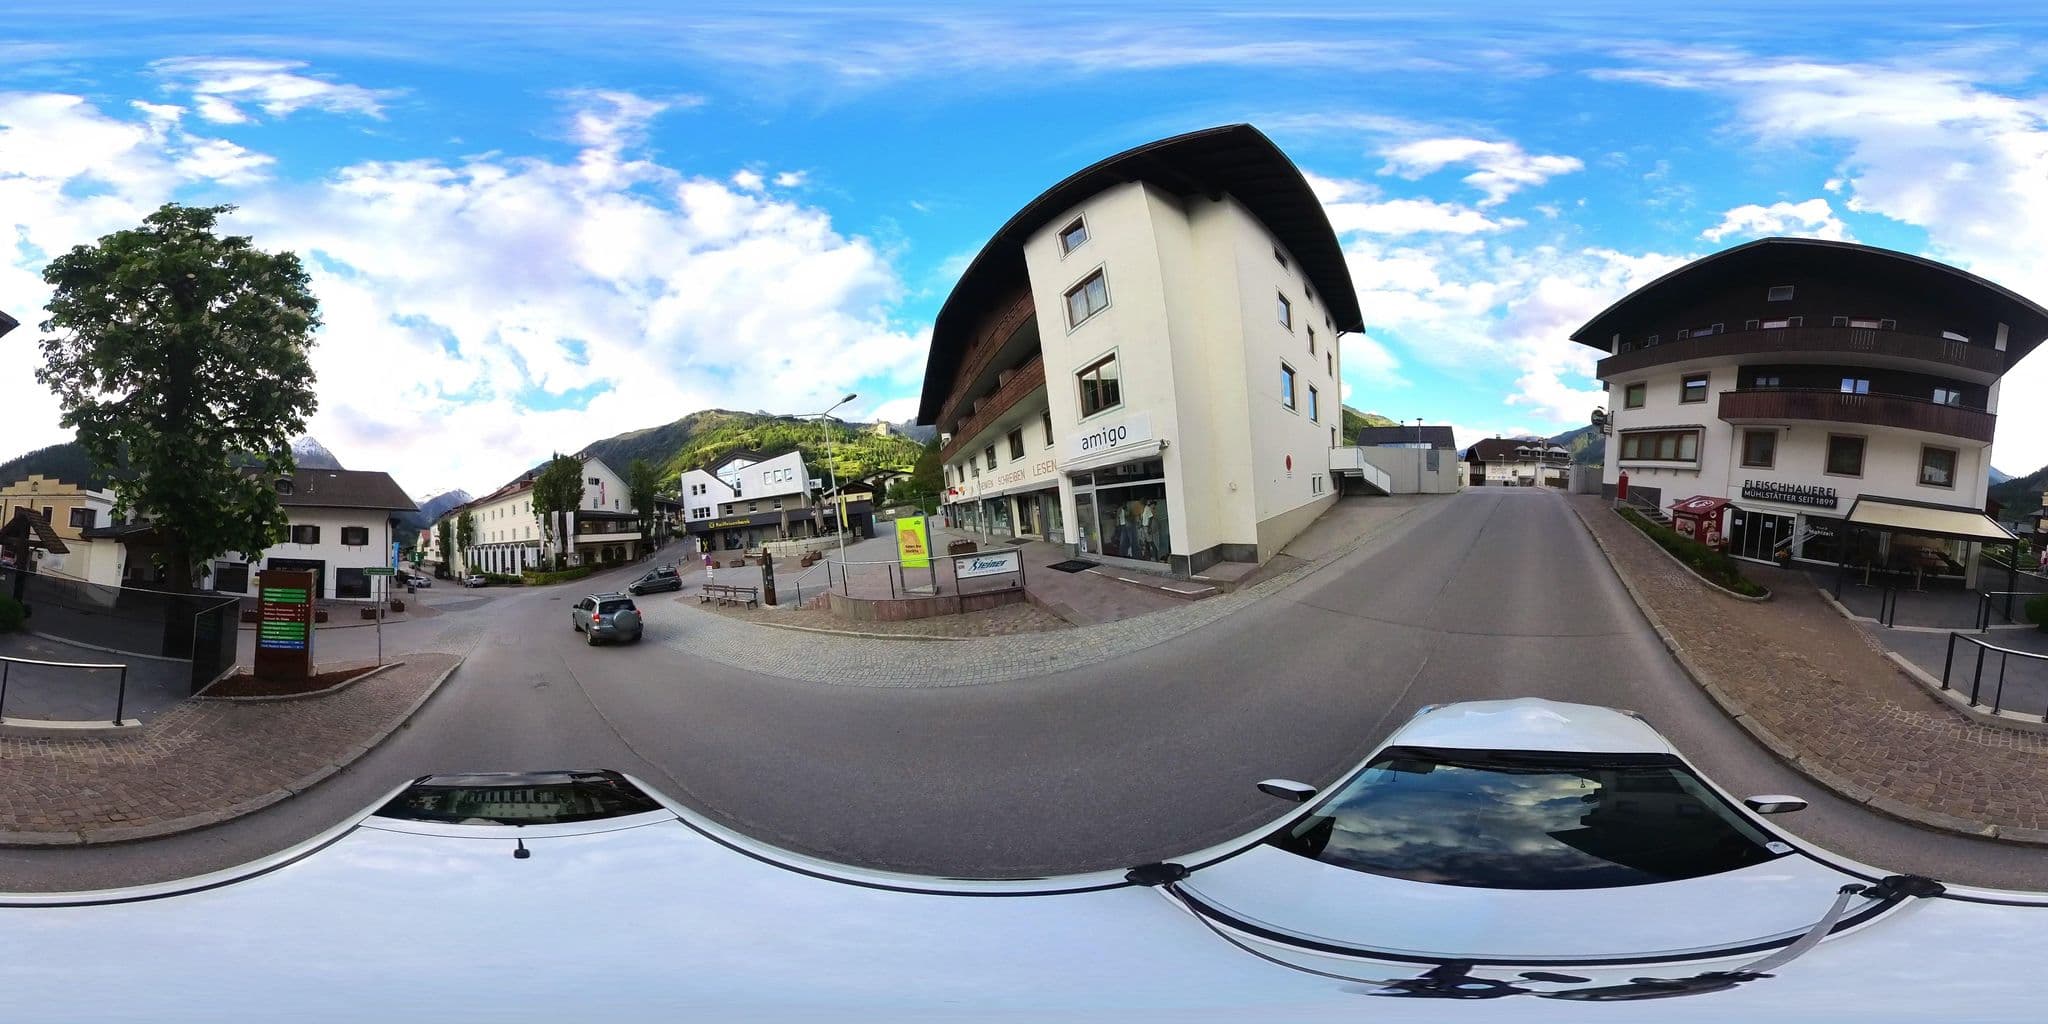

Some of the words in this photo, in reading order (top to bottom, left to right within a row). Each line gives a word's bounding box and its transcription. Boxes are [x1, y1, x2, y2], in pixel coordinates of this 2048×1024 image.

[1081, 425, 1127, 450] amigo
[1032, 458, 1058, 477] LESEN
[1744, 479, 1837, 498] FLEISCHHAUEREI
[1744, 489, 1796, 502] MÜHLSTÄTTER
[1798, 495, 1814, 505] SEIT
